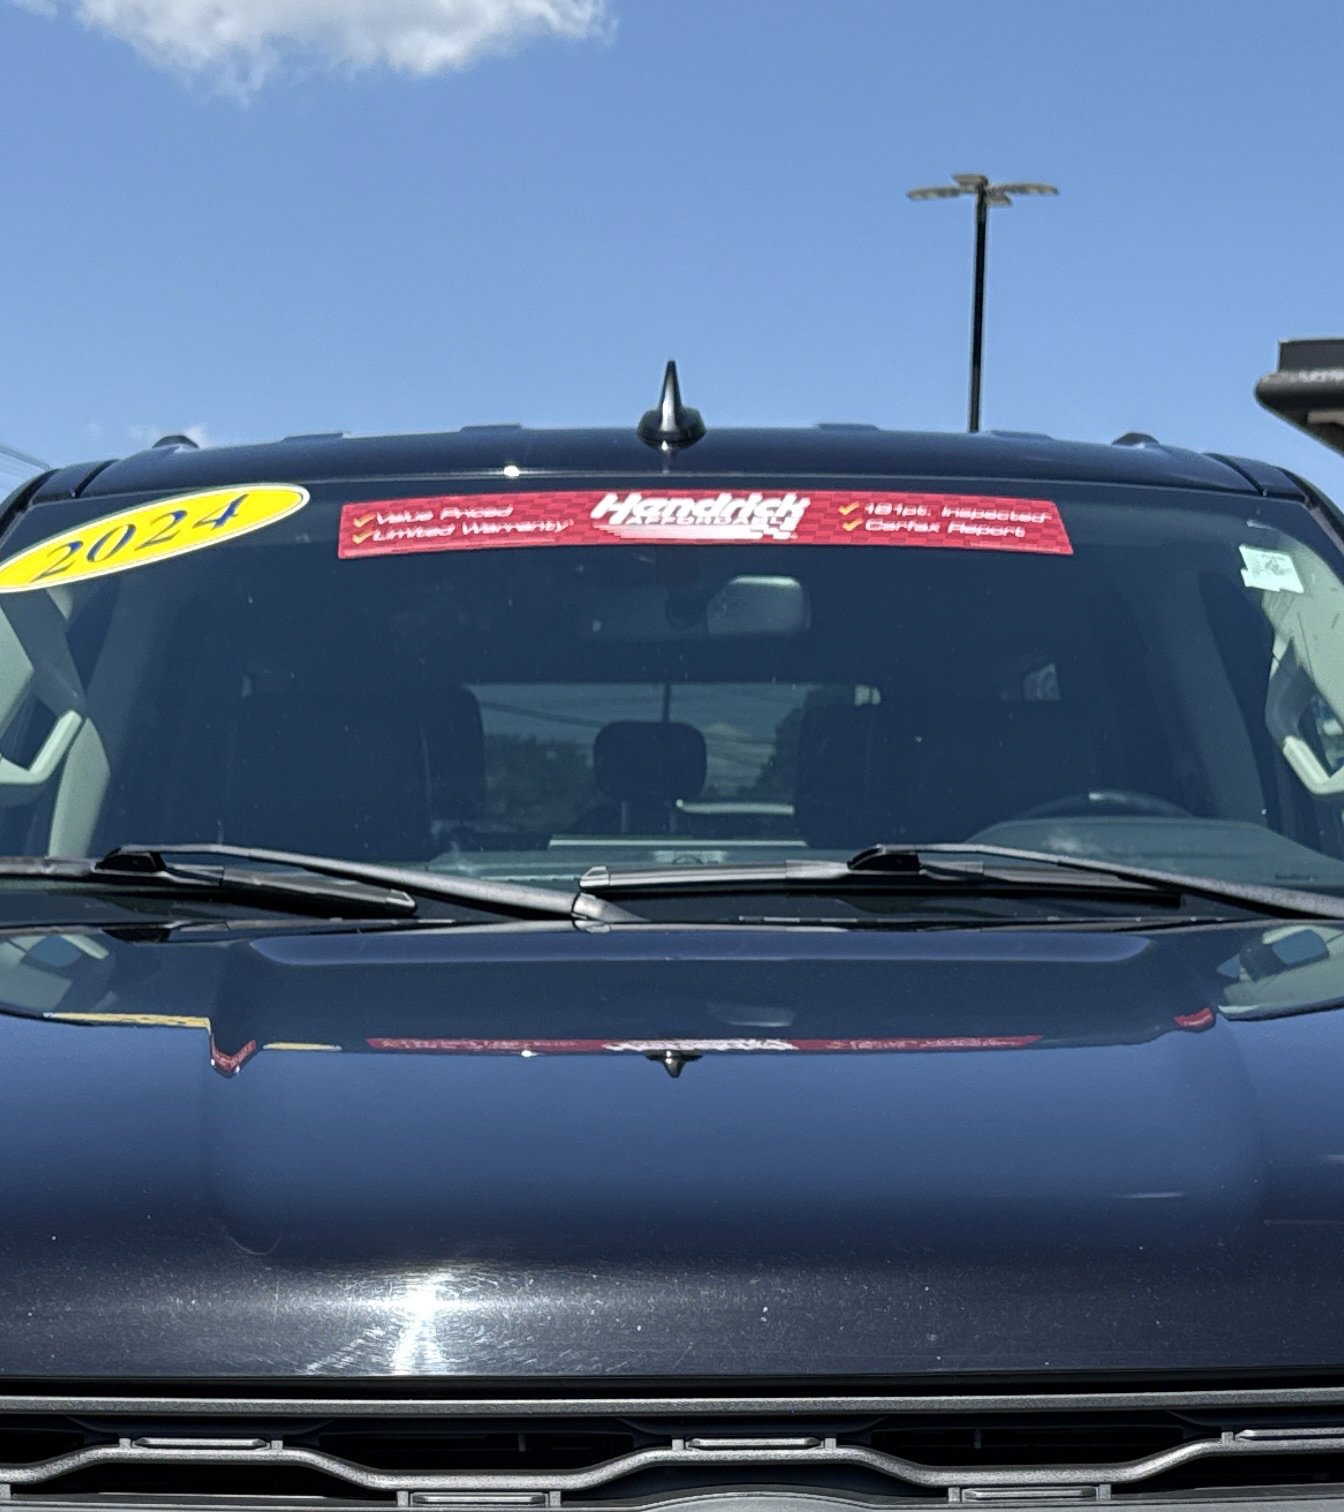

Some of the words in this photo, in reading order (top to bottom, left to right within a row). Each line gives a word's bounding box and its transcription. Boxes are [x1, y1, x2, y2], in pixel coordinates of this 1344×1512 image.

[590, 492, 811, 530] Hendrick
[29, 493, 249, 583] 2024
[372, 523, 456, 542] Limited
[865, 518, 941, 533] Carfax
[946, 520, 1026, 538] Report
